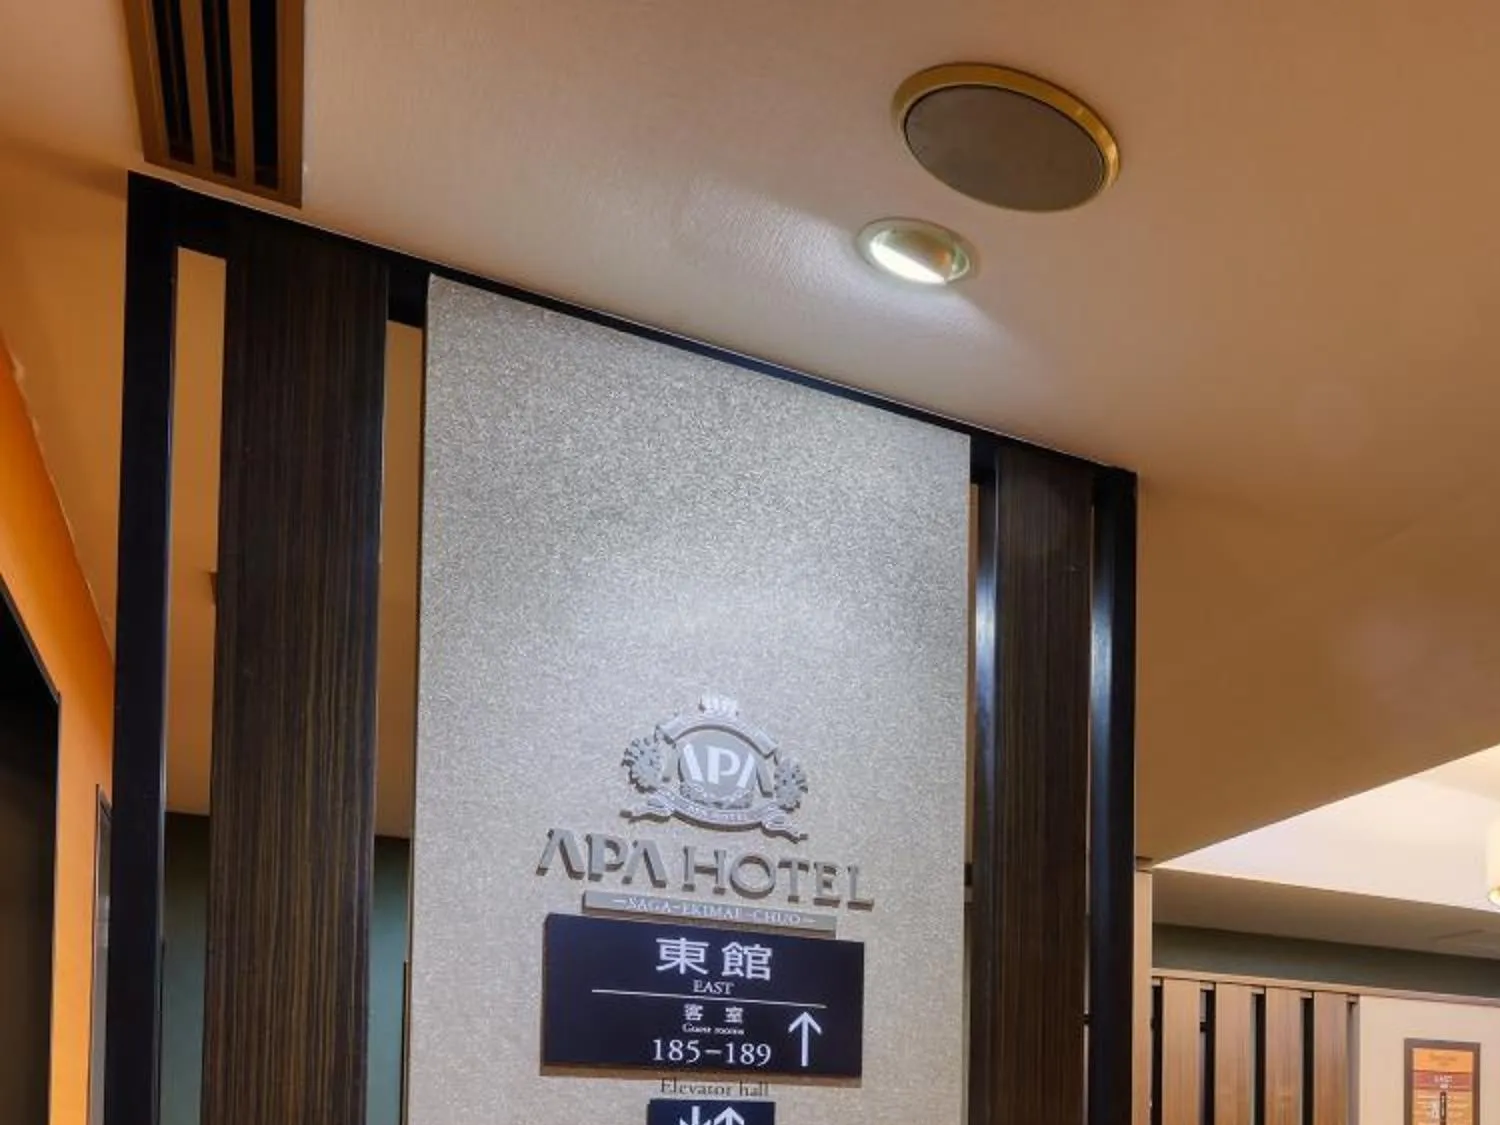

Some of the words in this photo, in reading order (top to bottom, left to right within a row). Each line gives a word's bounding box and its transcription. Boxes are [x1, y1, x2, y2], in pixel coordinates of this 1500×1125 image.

[535, 827, 668, 889] APA
[681, 844, 875, 912] HOTEL
[655, 937, 773, 981] 東館
[693, 979, 735, 995] EAST
[660, 1076, 733, 1096] Elevator
[738, 1080, 769, 1097] hall
